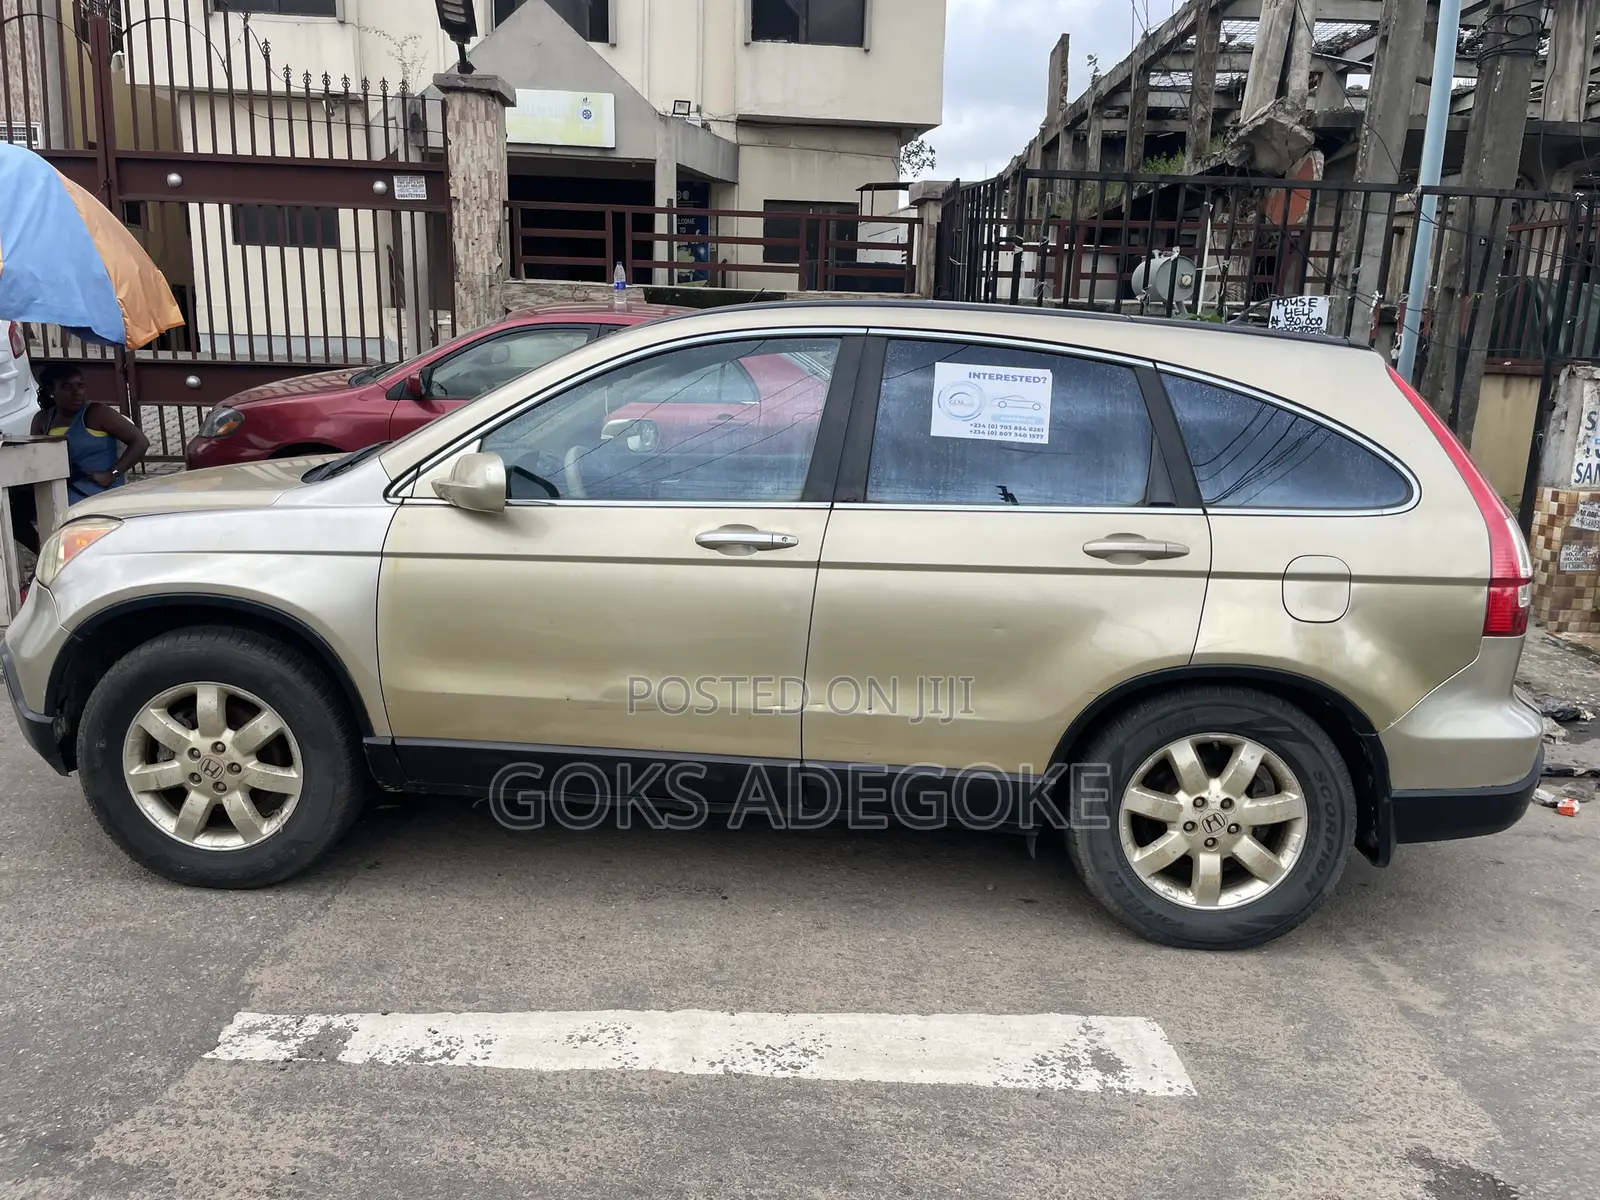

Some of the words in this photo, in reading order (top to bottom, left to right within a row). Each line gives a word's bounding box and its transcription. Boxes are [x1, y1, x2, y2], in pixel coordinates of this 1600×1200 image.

[1284, 307, 1313, 318] HELP
[968, 371, 1048, 384] INTERESTED?
[1304, 771, 1337, 898] SCORPION
